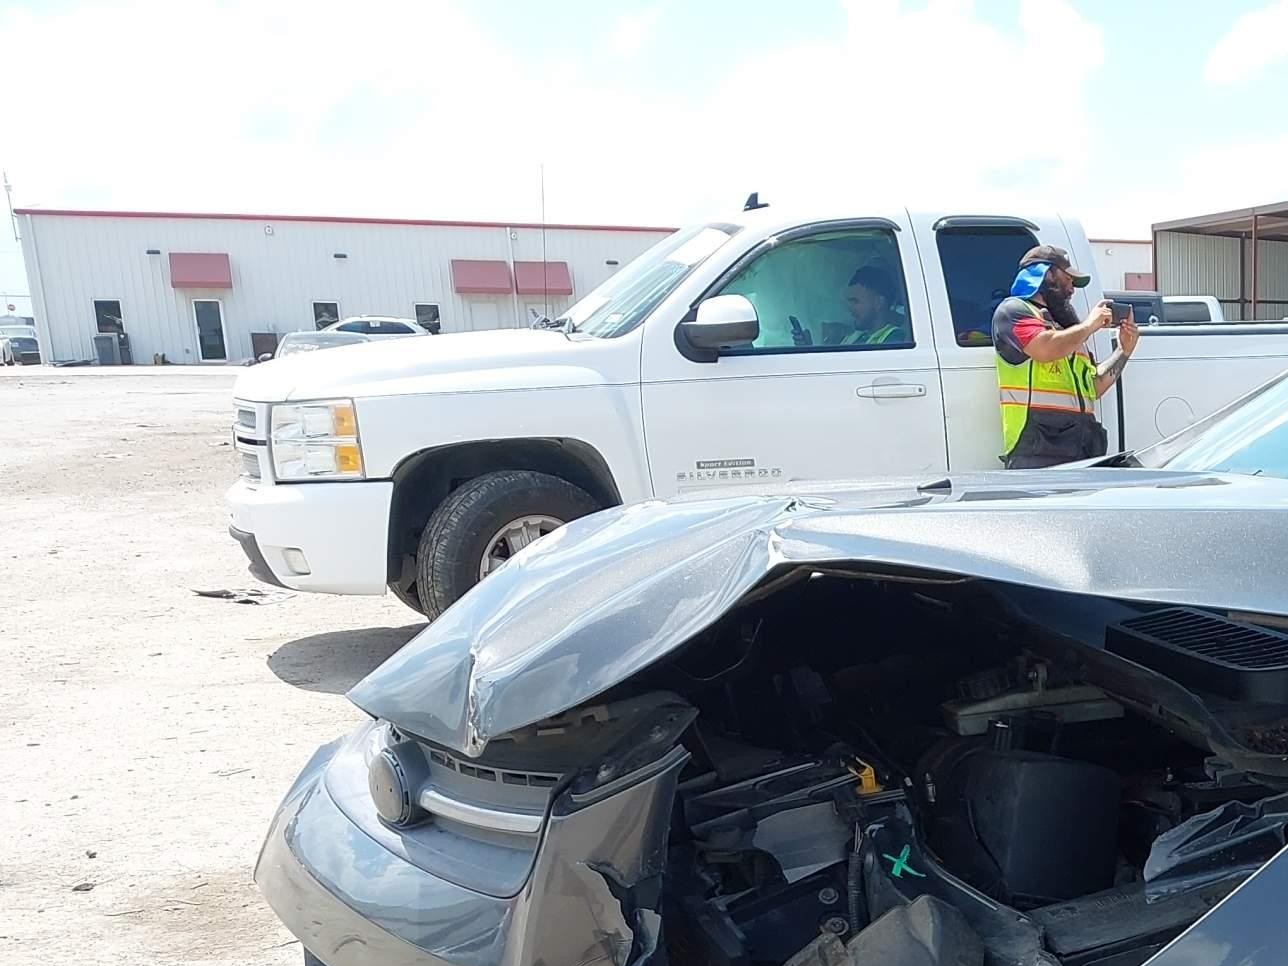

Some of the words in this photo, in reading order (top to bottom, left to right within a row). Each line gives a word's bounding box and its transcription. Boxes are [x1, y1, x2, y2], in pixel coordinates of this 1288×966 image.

[699, 461, 722, 469] Sport
[723, 459, 753, 467] Edition
[677, 468, 781, 481] SILVERADO
